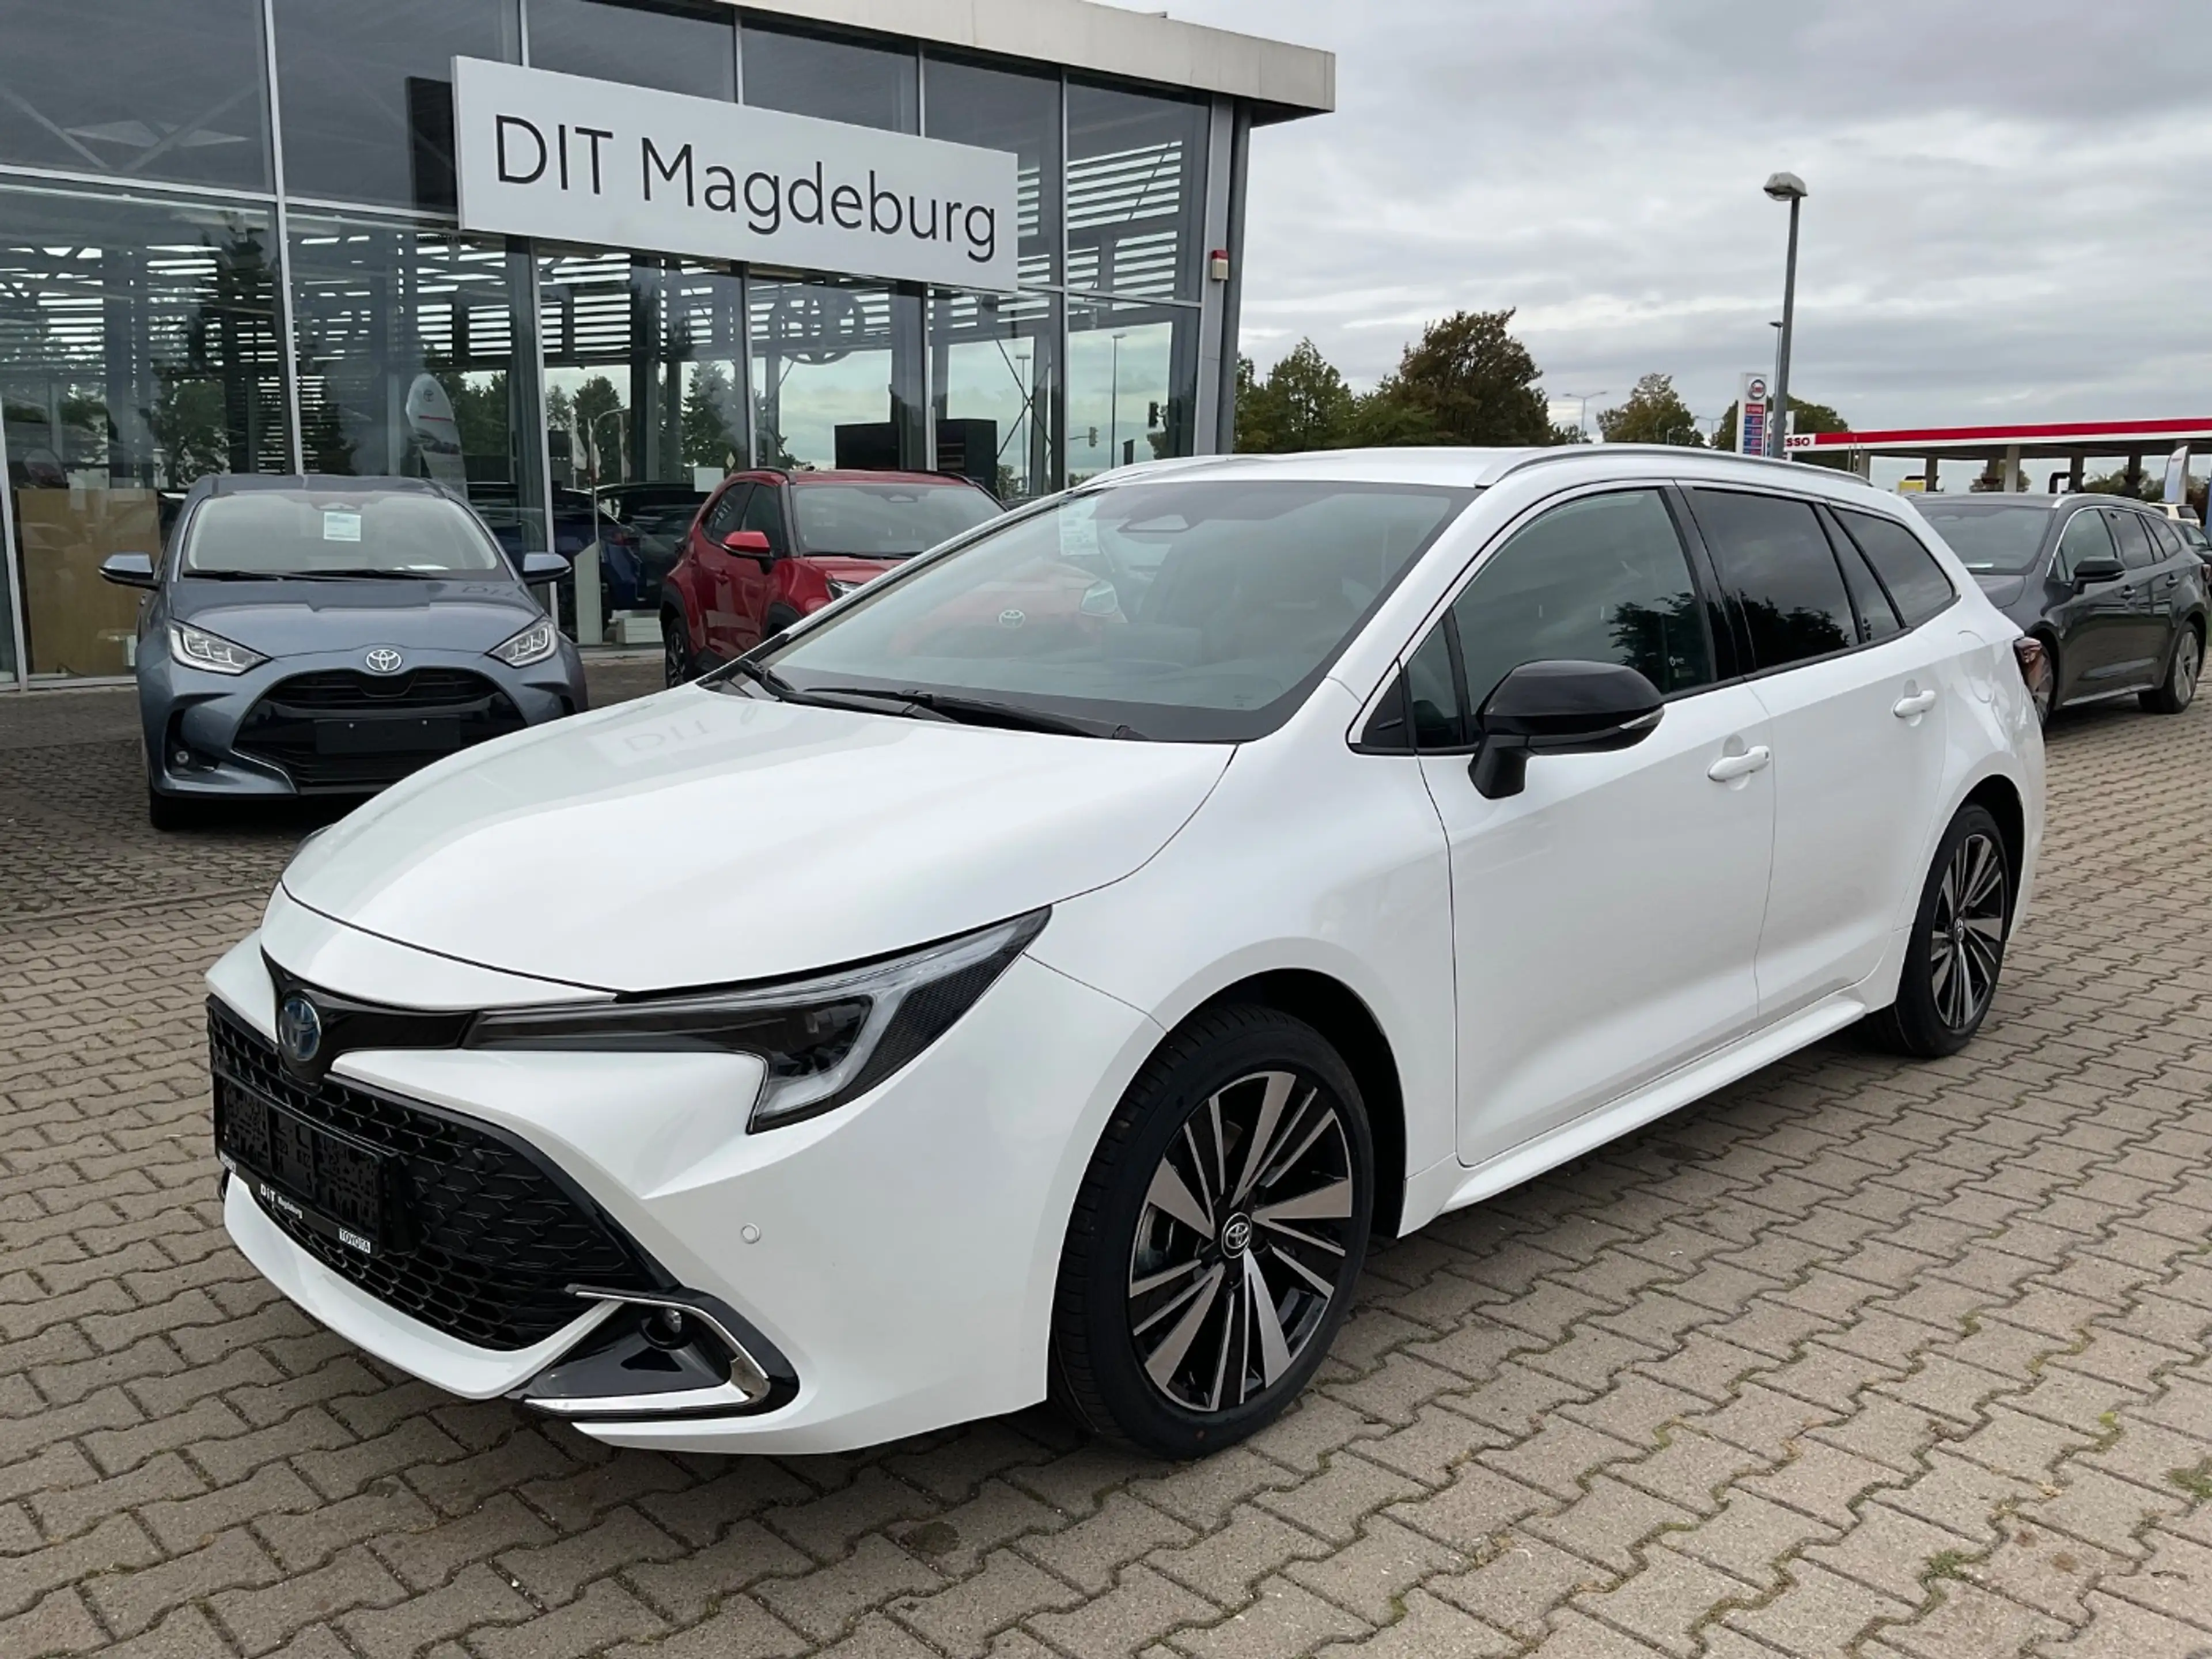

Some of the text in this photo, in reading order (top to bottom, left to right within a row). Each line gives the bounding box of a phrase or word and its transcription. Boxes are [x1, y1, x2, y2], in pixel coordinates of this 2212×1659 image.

[495, 114, 995, 263] DIT Magdeburg
[1786, 437, 1810, 447] SSO
